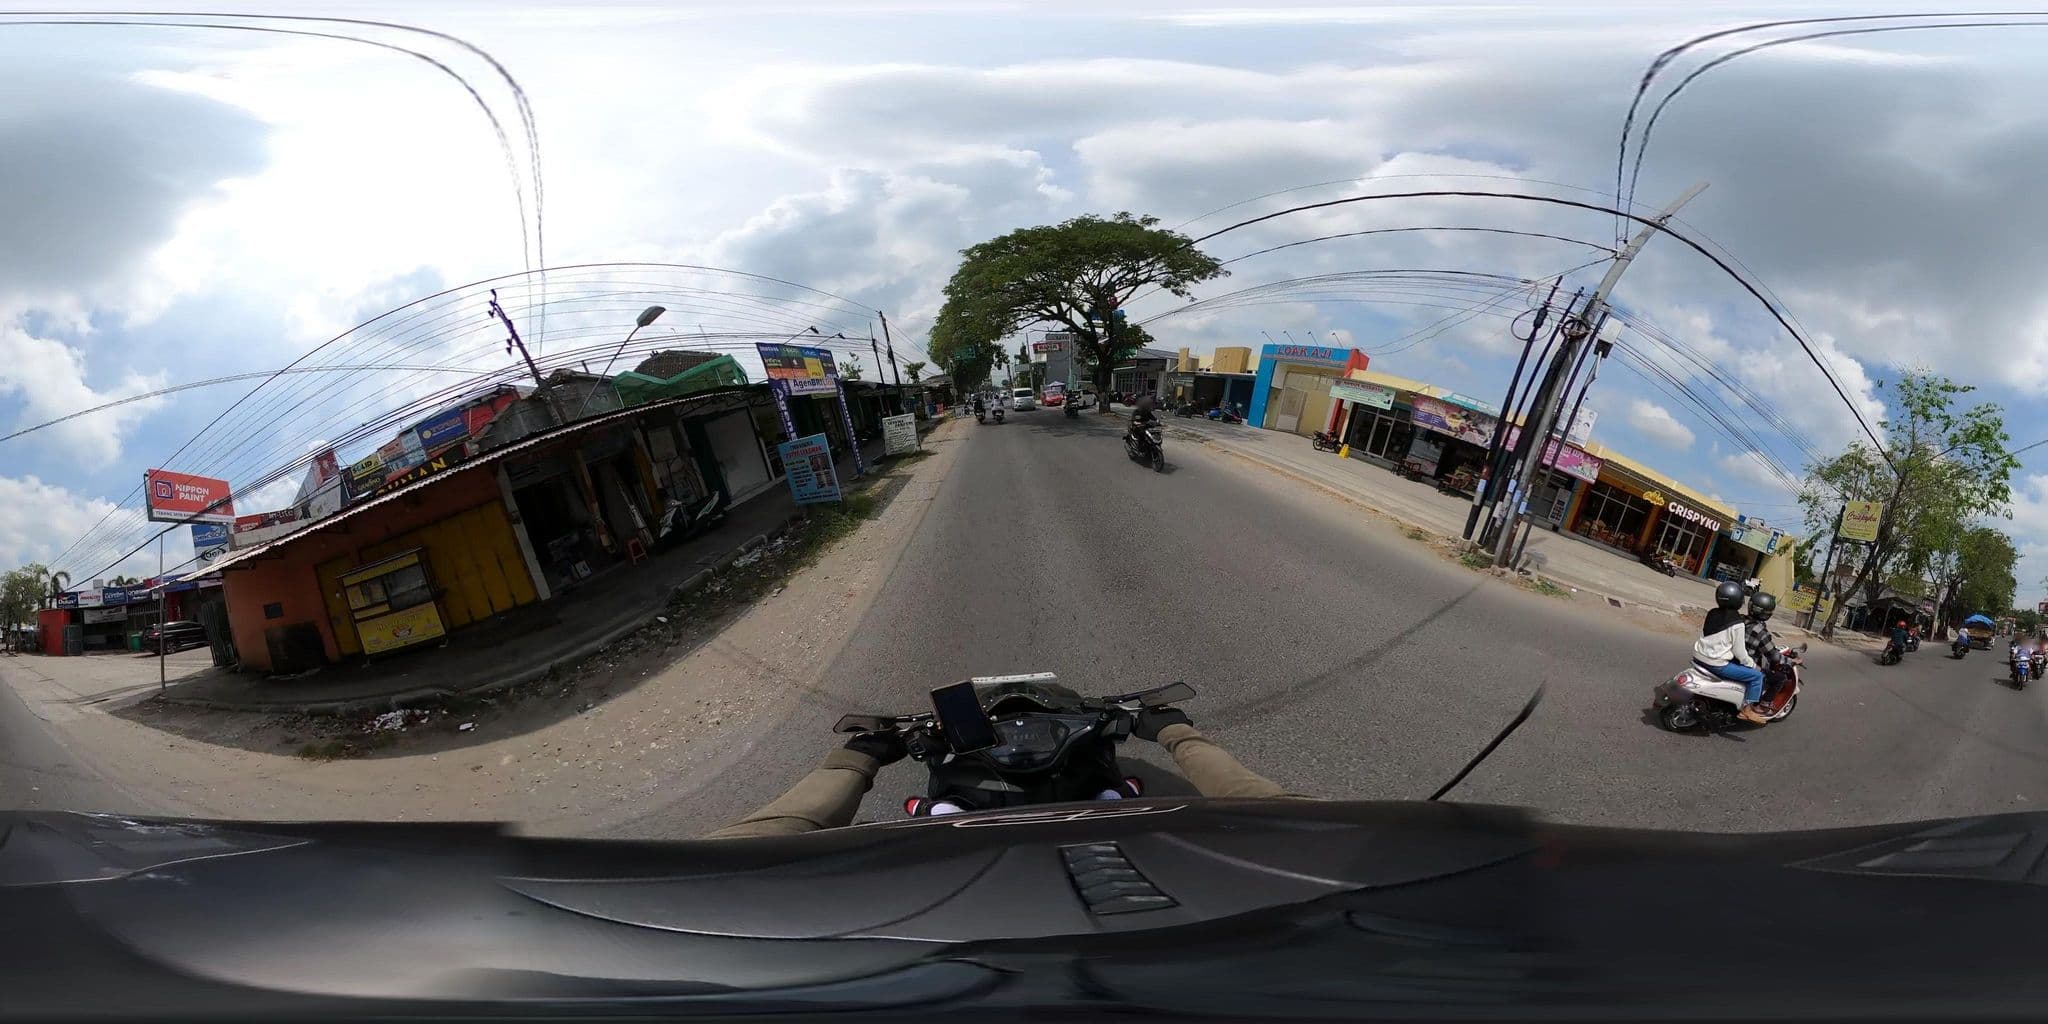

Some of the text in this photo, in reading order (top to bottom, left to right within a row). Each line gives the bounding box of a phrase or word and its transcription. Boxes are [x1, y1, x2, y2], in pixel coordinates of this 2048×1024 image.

[1278, 345, 1332, 359] LOAK AJI
[175, 483, 209, 496] NIPPON
[179, 492, 205, 502] PAINT
[1668, 502, 1720, 532] CRISPYKU
